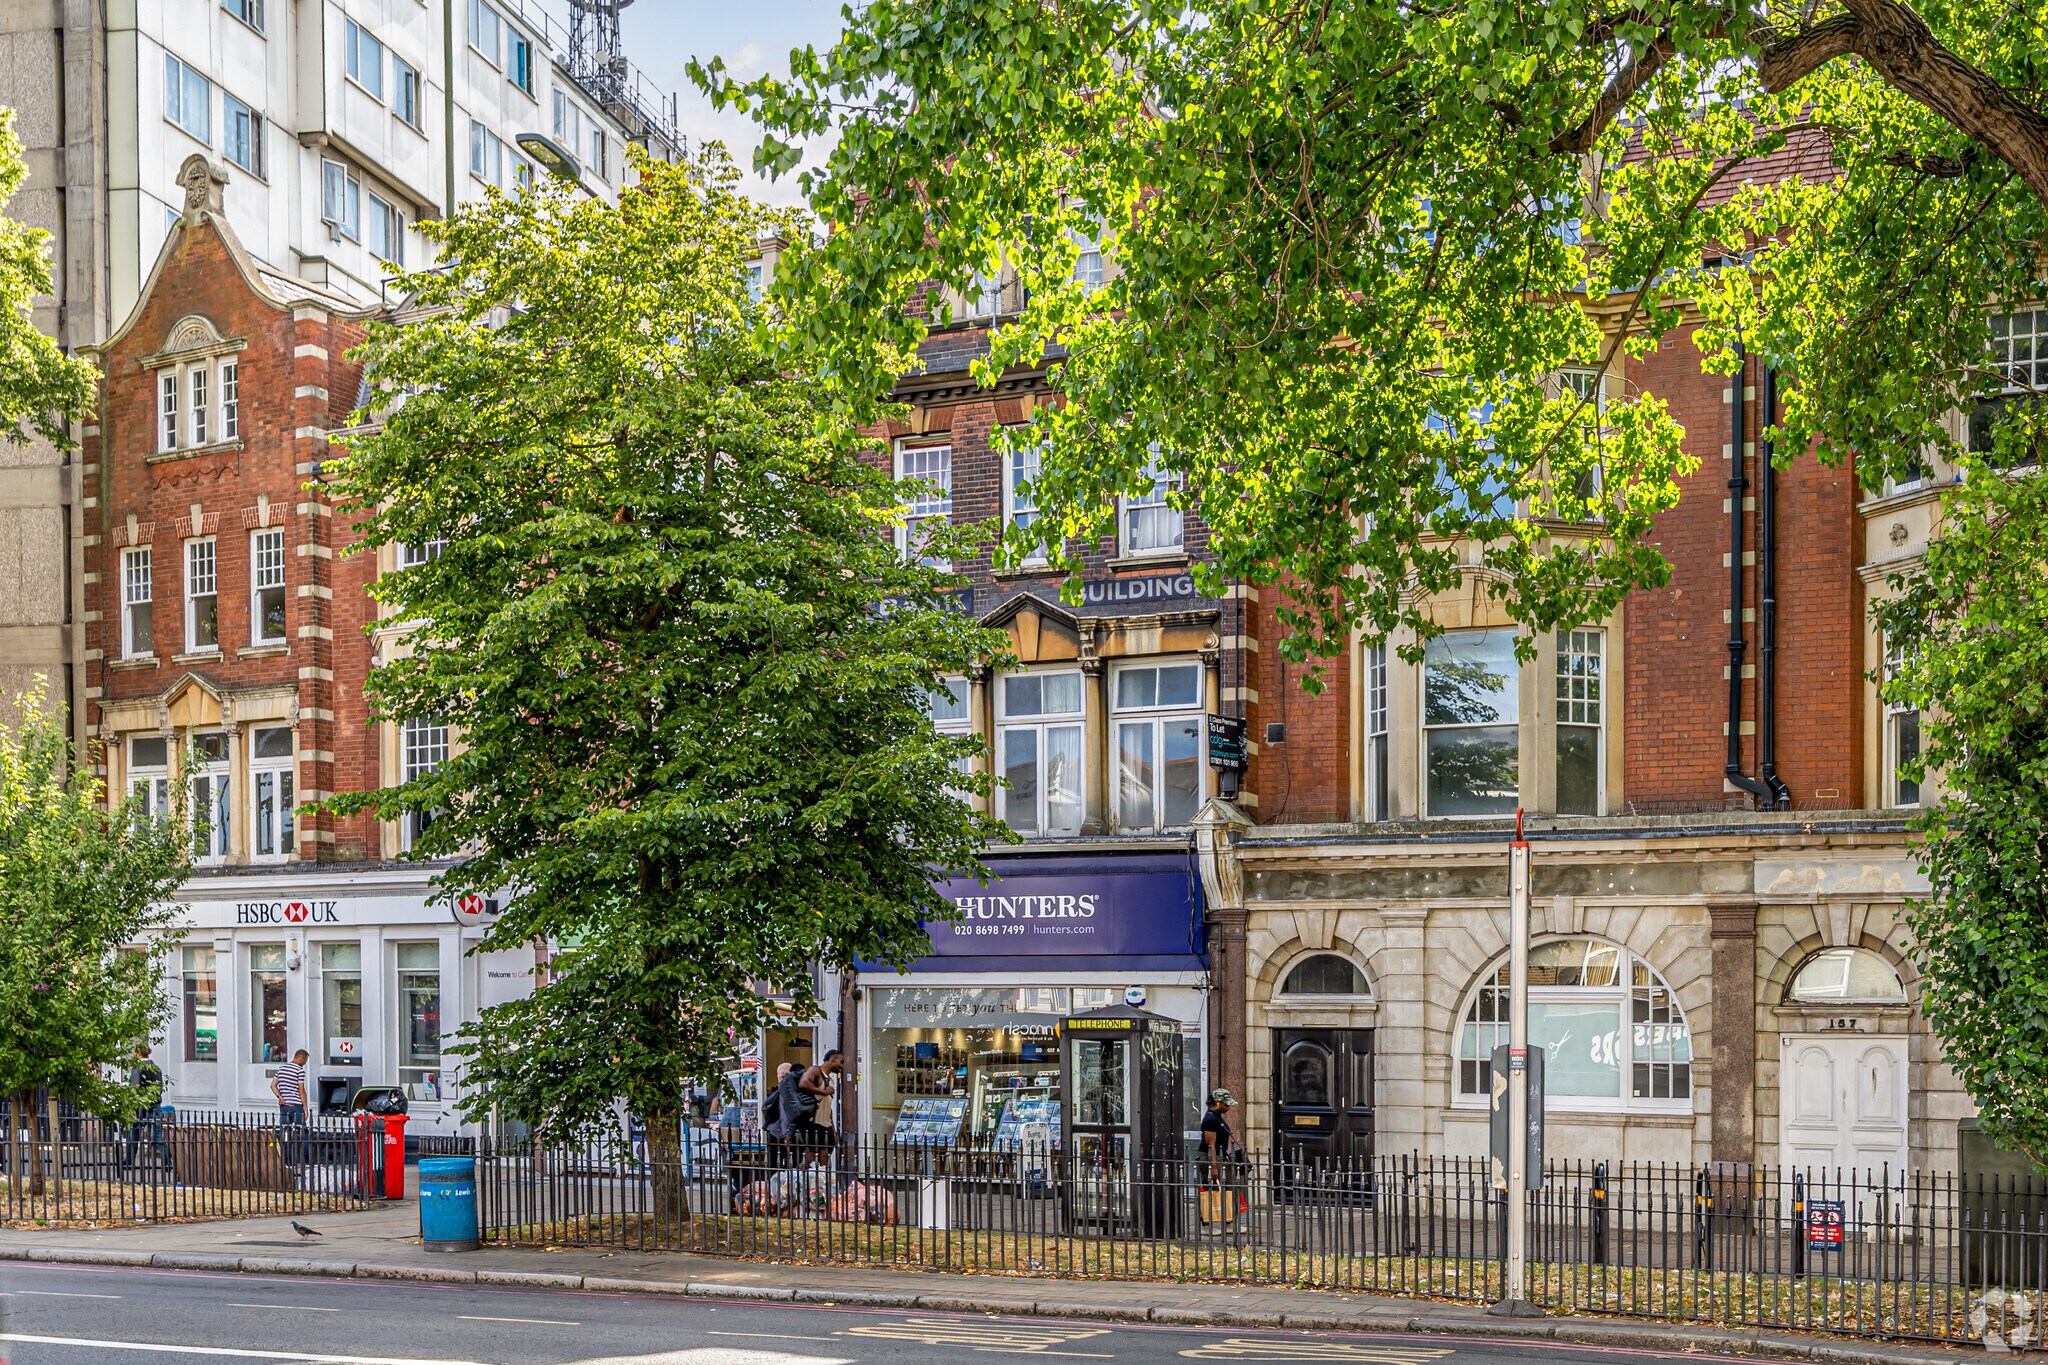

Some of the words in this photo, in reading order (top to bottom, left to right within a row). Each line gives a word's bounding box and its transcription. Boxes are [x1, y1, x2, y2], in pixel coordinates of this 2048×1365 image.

[1080, 575, 1202, 602] UILDING
[236, 903, 282, 924] HSBC
[310, 901, 340, 923] UK
[954, 894, 1096, 919] HUNTERS
[955, 925, 973, 935] 020
[975, 925, 999, 935] 8698
[1002, 924, 1025, 935] 7499
[1033, 924, 1095, 935] hunters.com
[904, 1004, 929, 1012] HERE
[972, 1004, 996, 1017] you
[1073, 1020, 1125, 1029] TELEPHONE
